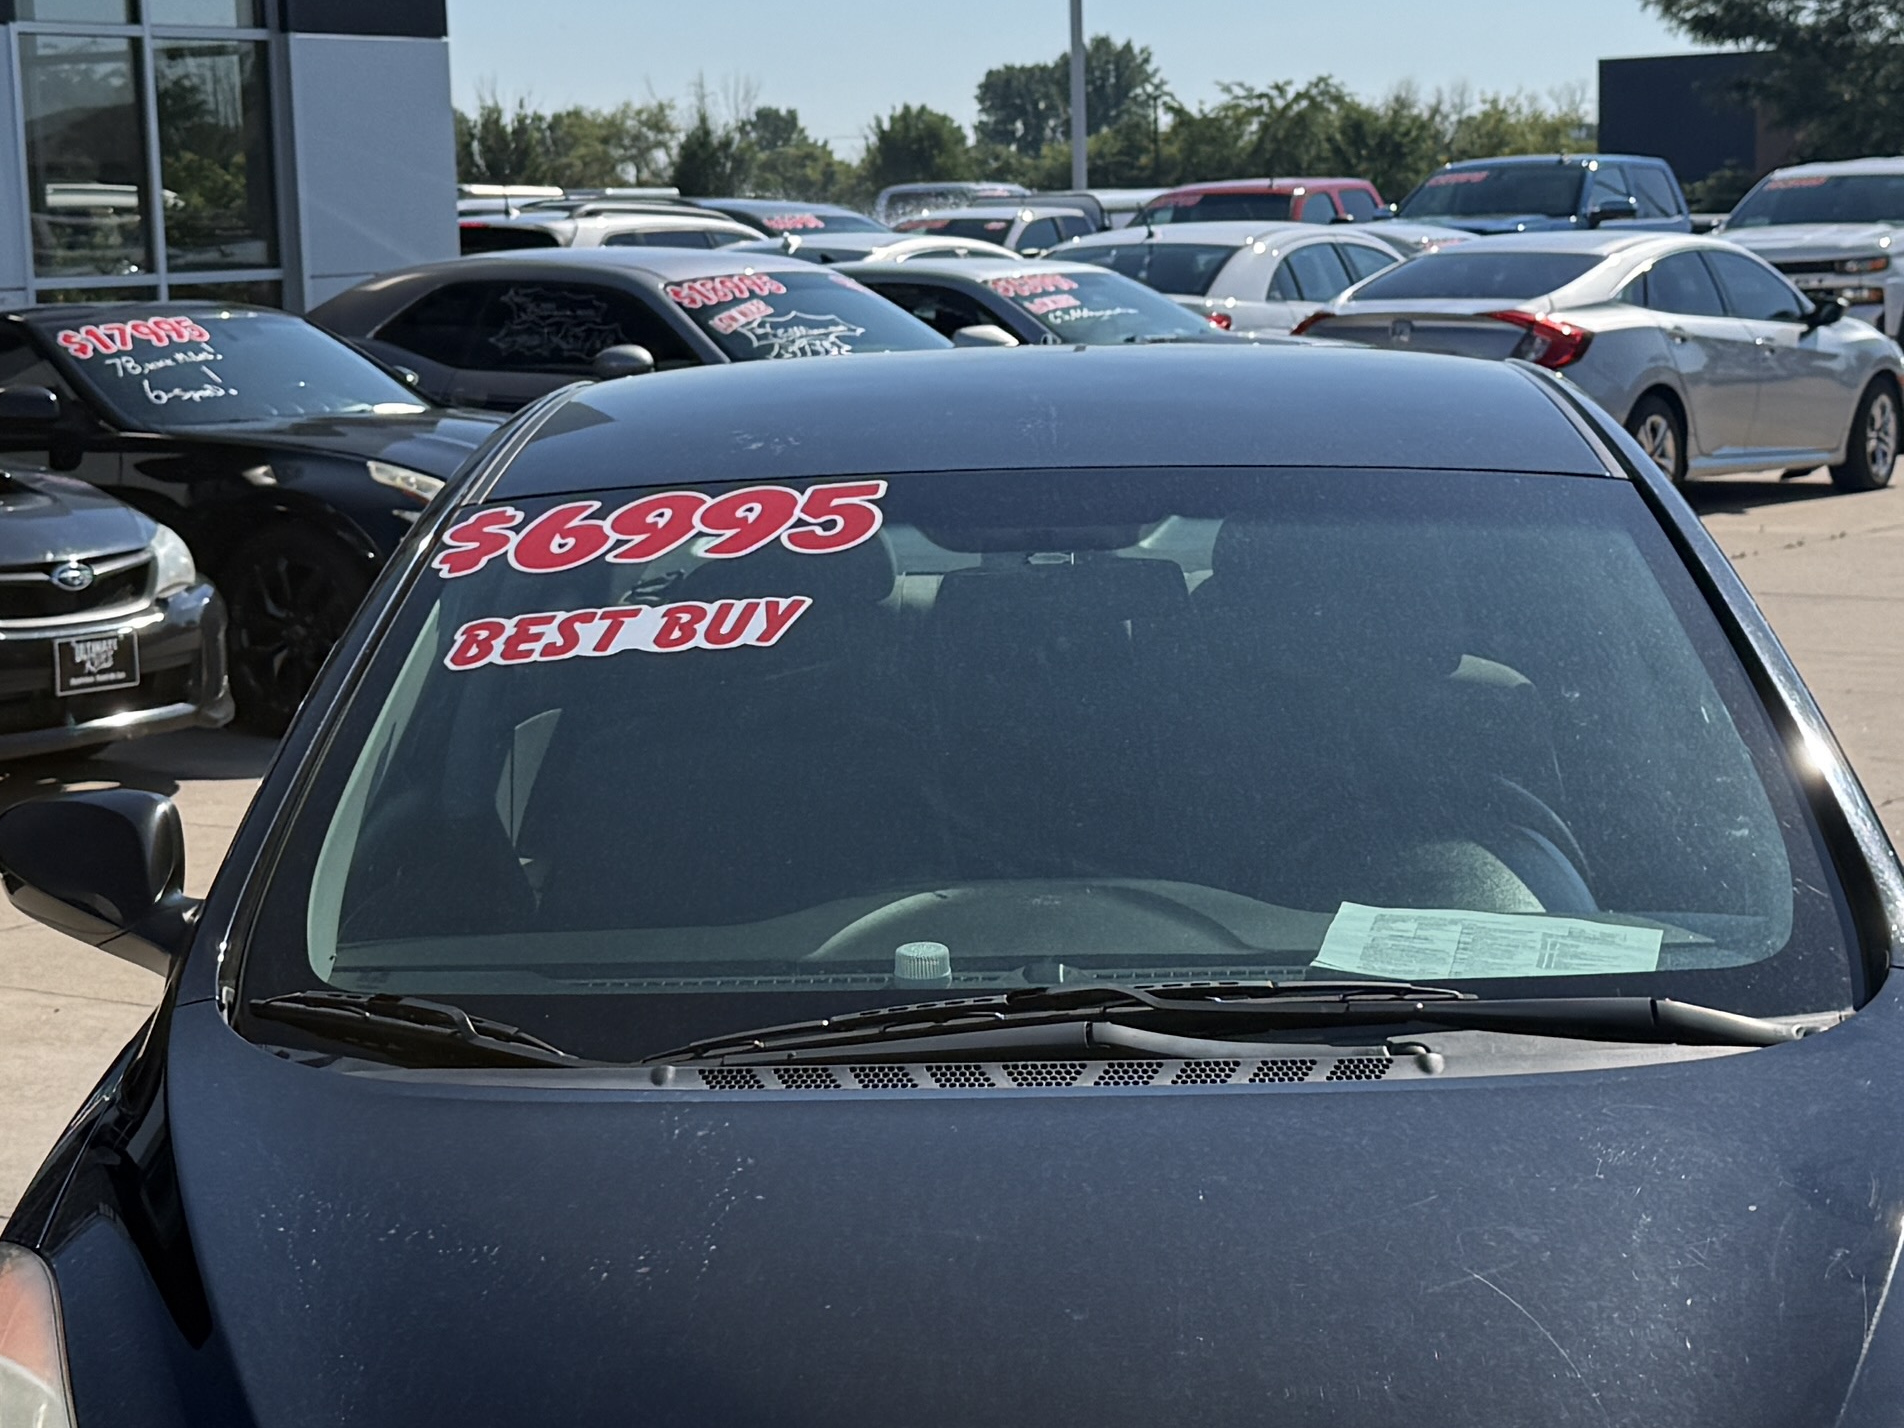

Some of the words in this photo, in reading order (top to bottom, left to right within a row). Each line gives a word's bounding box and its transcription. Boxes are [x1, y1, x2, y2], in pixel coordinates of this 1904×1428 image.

[57, 316, 210, 359] $17995
[432, 480, 888, 578] $6995
[446, 606, 645, 669] BEST
[651, 597, 810, 651] BUY
